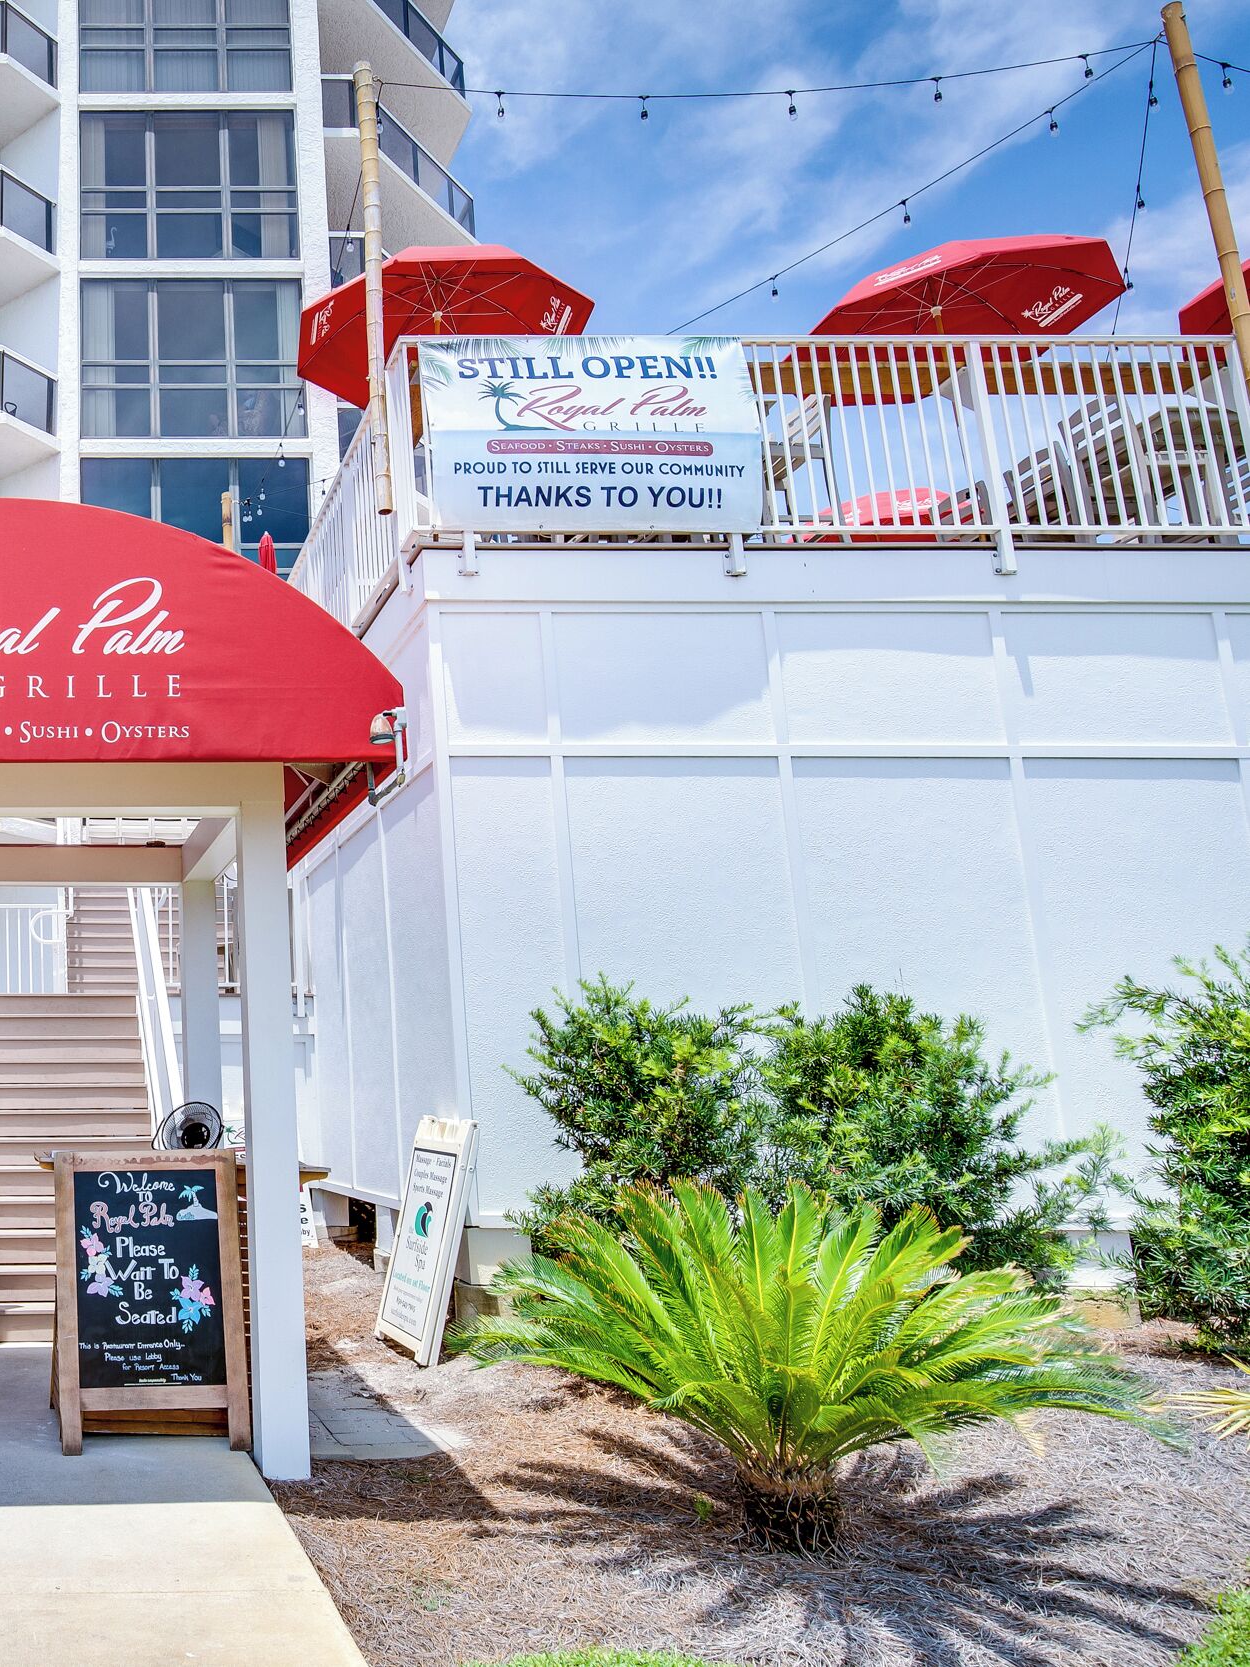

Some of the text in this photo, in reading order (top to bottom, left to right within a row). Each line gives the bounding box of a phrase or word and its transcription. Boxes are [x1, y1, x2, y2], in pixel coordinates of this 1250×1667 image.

[458, 355, 718, 380] STILL OPEN!!
[517, 384, 708, 431] Royal Palm
[583, 420, 705, 433] GRILLE
[454, 461, 746, 478] PROUD TO STILL SERVE OUR COMMUNITY
[477, 485, 723, 509] THANKS TO YOU!!
[71, 576, 185, 655] Palm
[97, 1172, 176, 1194] Welcome
[90, 1201, 175, 1233] Royal Palm
[115, 1236, 167, 1258] Please
[158, 1258, 180, 1280] To
[414, 1254, 426, 1272] Spa
[134, 1282, 153, 1301] Be
[78, 1342, 92, 1350] This
[93, 1342, 100, 1350] is
[104, 1352, 125, 1362] Please
[145, 1352, 163, 1363] Lobby
[171, 1373, 203, 1381] Thank You
